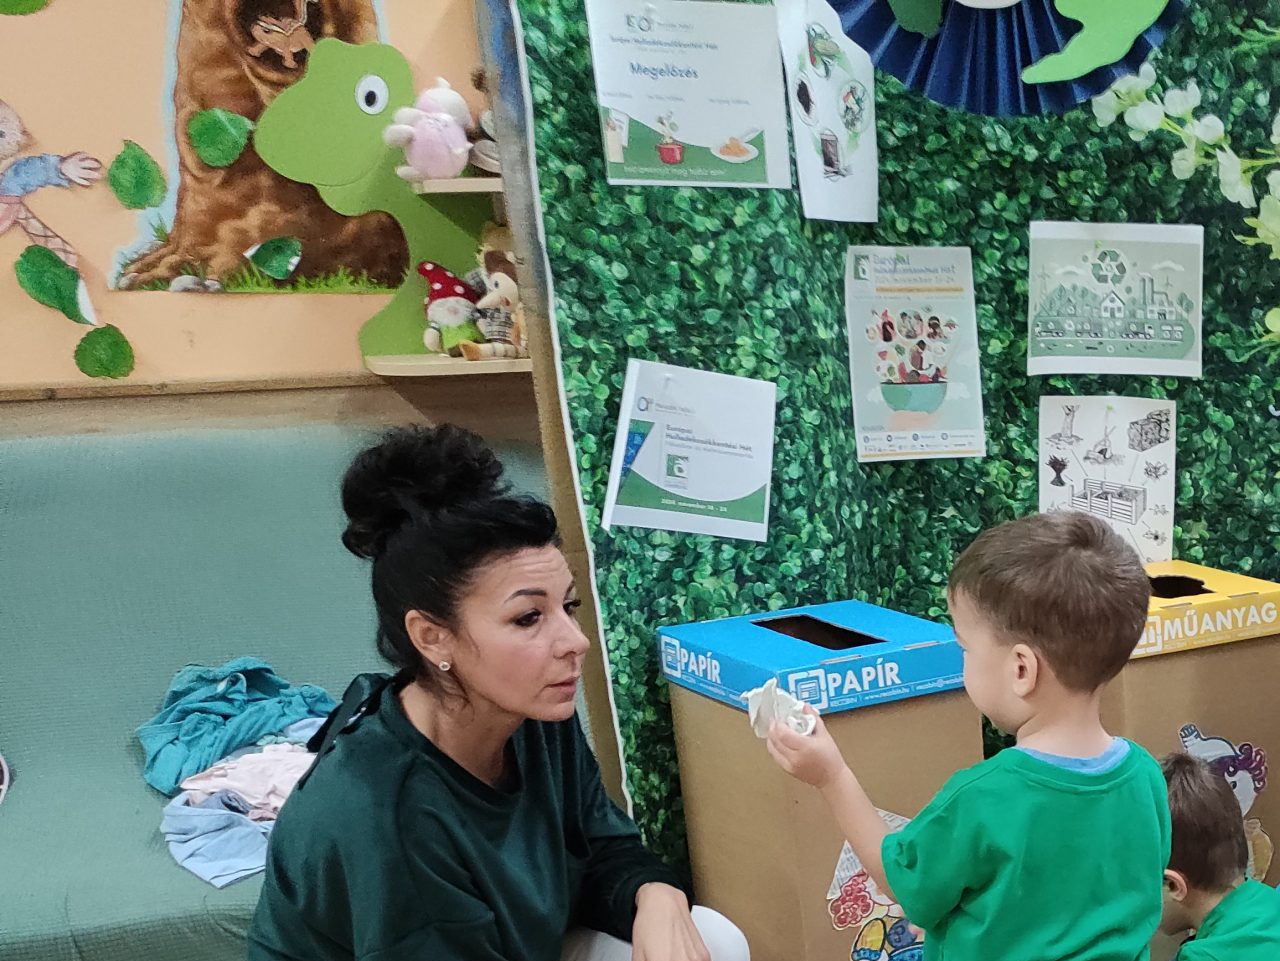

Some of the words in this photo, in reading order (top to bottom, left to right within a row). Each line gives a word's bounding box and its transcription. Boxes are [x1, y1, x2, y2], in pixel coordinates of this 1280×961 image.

[630, 62, 698, 80] Megelőzés
[1163, 602, 1278, 641] MŰANYAG
[680, 647, 721, 685] PAPÍR
[826, 658, 902, 697] PAPÍR
